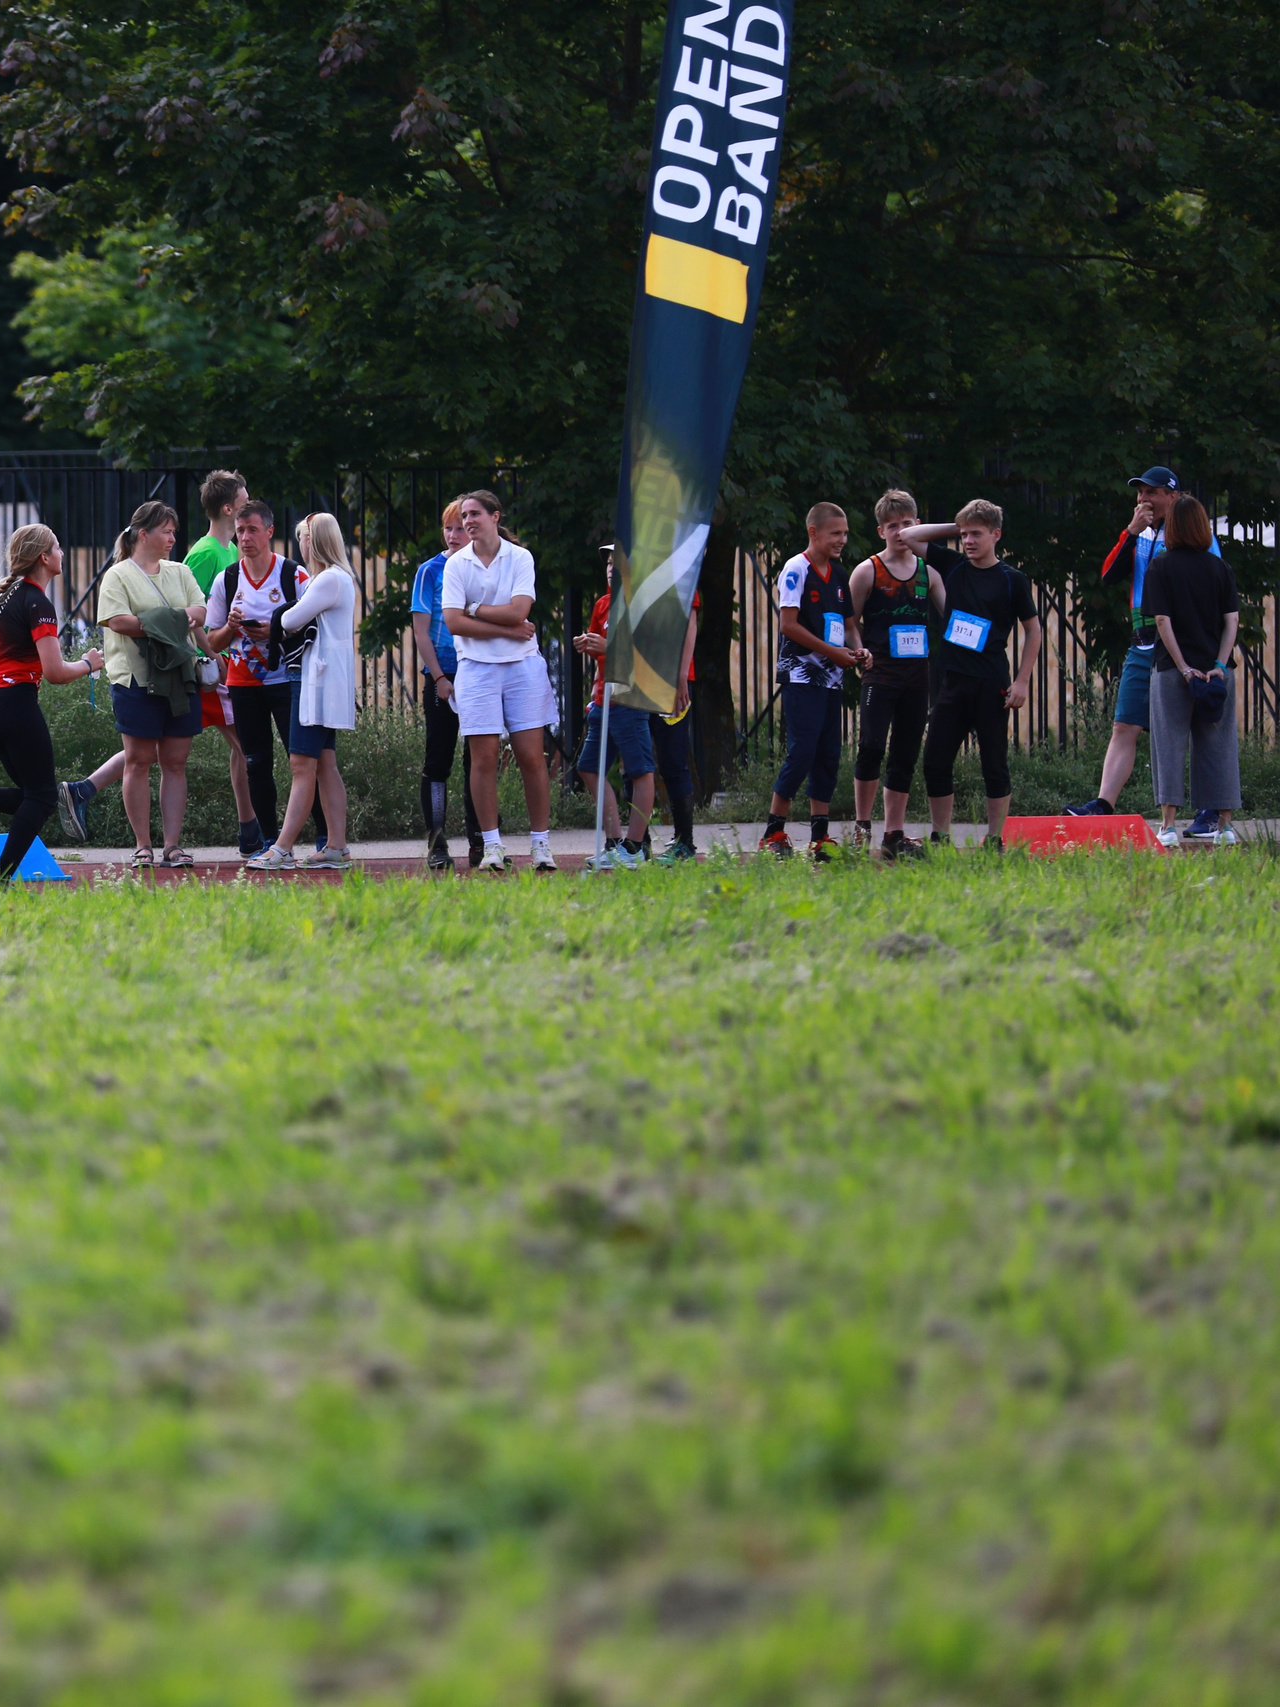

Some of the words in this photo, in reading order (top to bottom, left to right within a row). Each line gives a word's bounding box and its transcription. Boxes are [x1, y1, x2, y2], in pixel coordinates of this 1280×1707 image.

[652, 0, 730, 224] OPEN
[713, 5, 785, 245] BAND
[955, 625, 973, 637] 317.1
